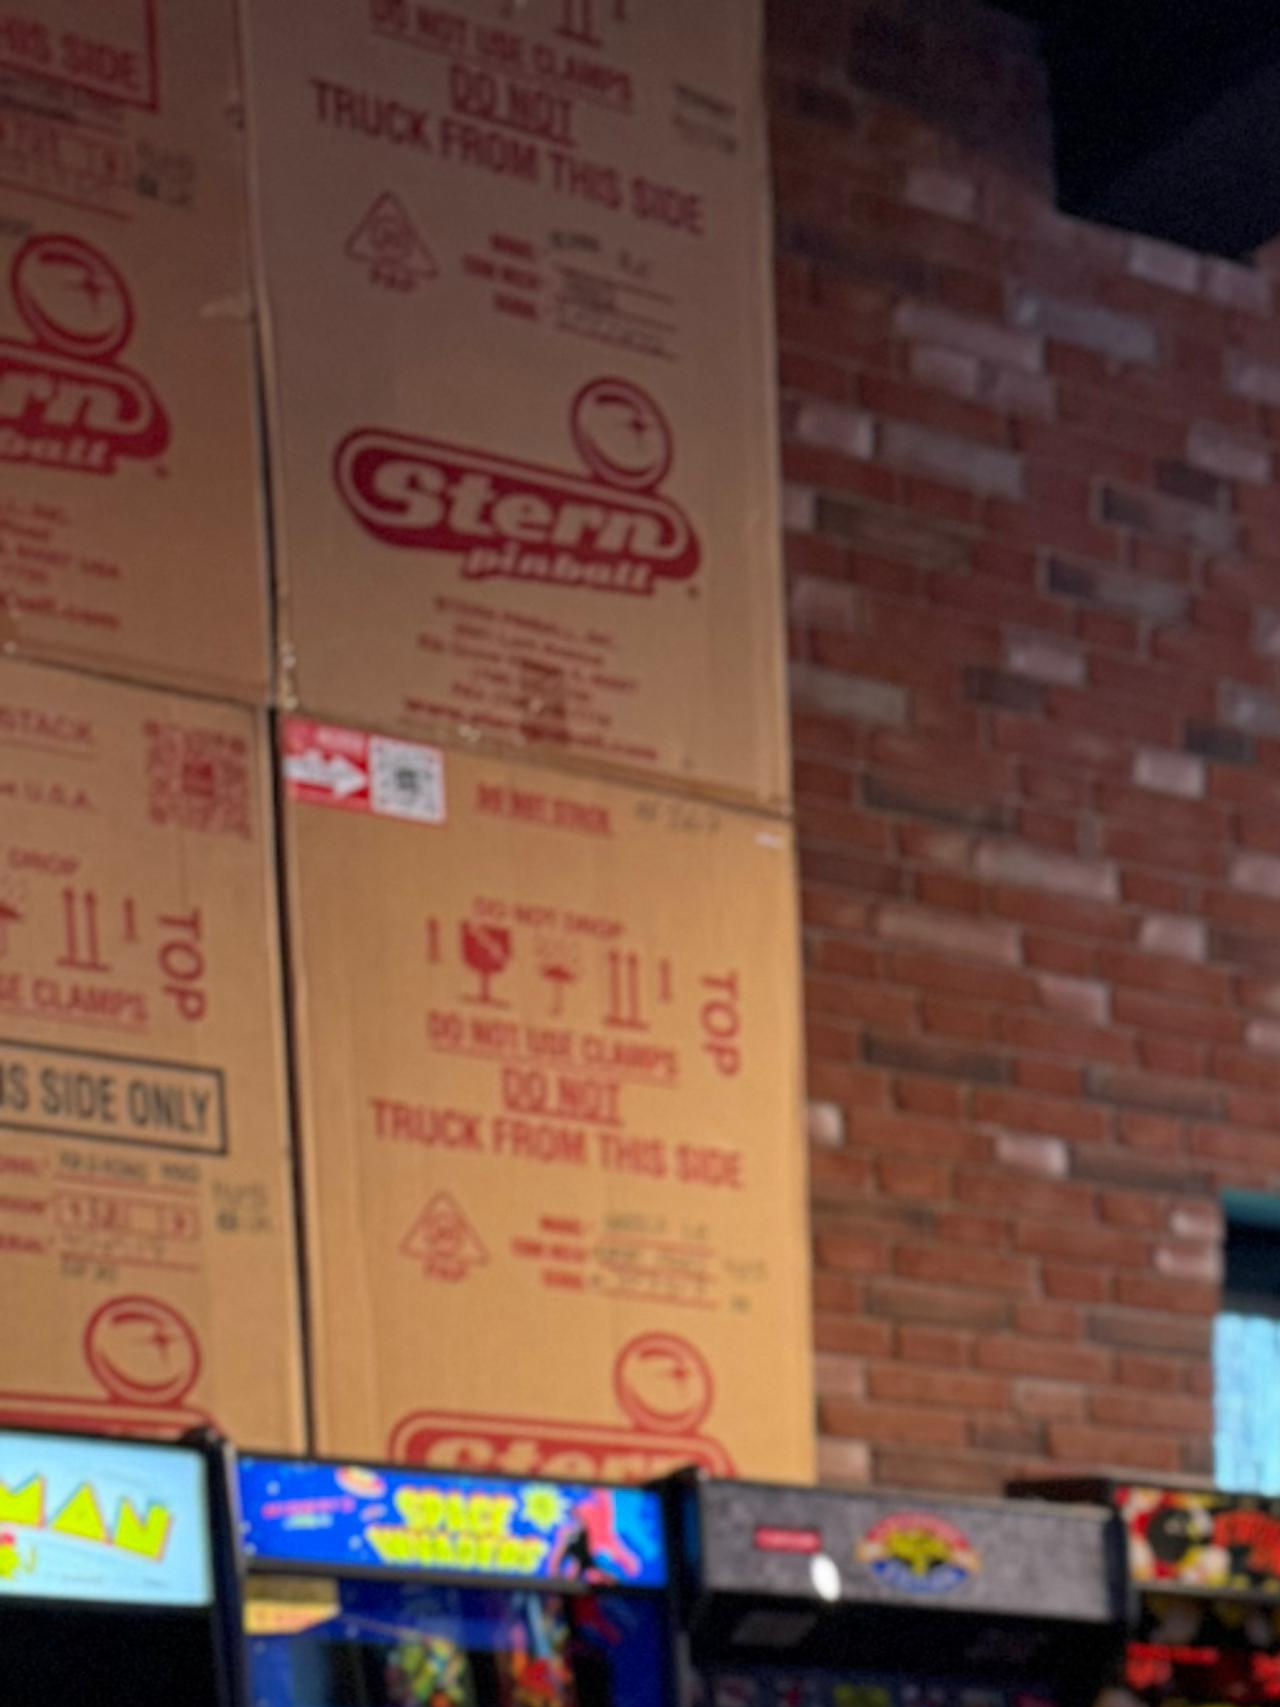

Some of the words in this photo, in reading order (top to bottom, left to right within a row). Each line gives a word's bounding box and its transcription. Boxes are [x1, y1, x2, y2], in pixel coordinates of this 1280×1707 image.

[371, 458, 689, 560] Stern
[157, 907, 206, 1022] TOP
[700, 970, 742, 1077] TOP
[40, 1069, 118, 1123] SIDE
[128, 1080, 211, 1135] ONLY
[371, 1098, 484, 1152] TRUCK
[492, 1116, 586, 1165] FROM
[676, 1143, 743, 1190] SIDE
